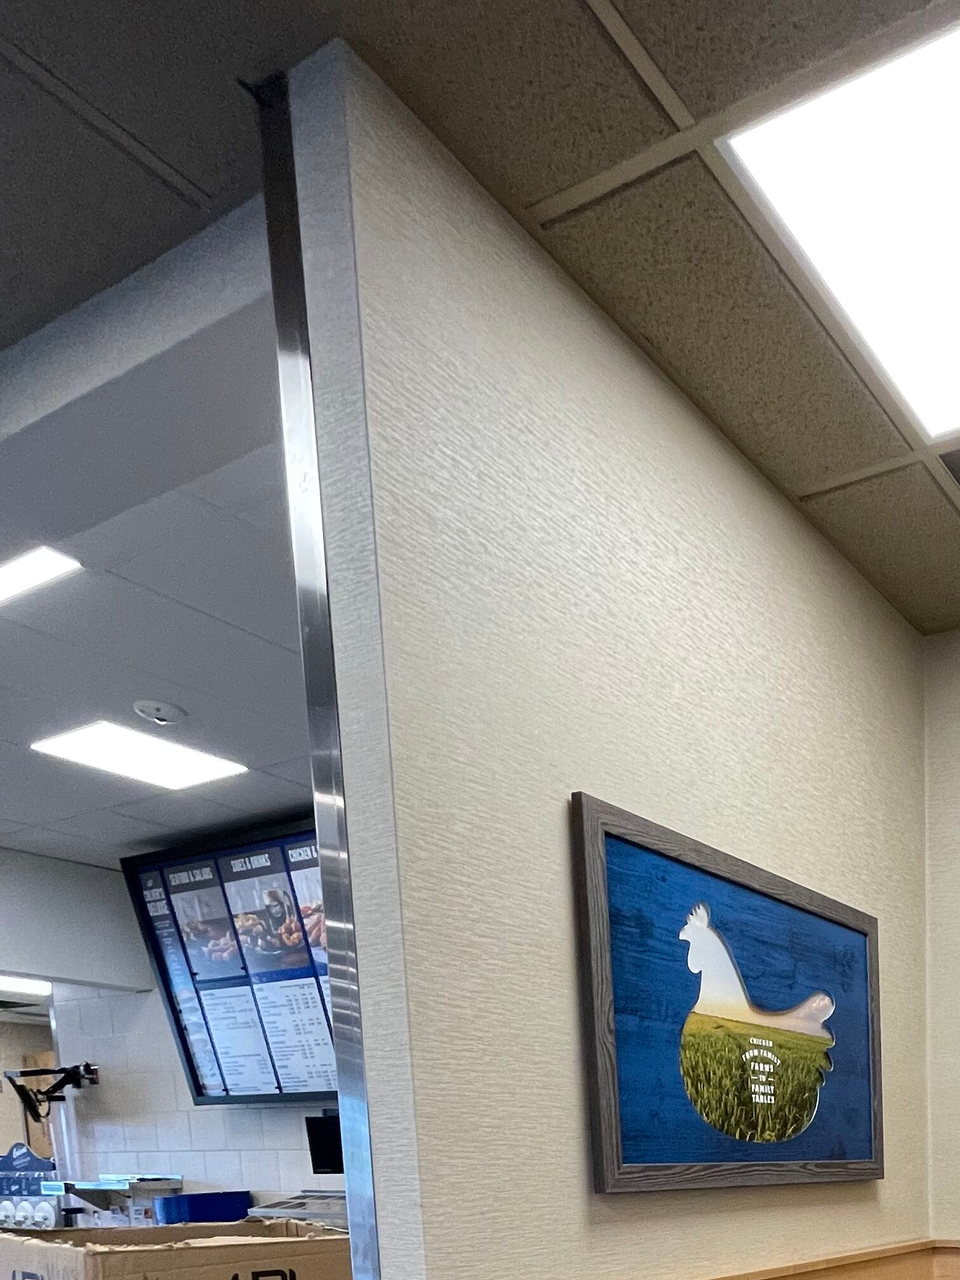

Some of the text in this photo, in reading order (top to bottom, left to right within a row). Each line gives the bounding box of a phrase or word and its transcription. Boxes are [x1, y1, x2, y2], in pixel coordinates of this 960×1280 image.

[749, 1037, 773, 1047] CHICKEN
[742, 1049, 781, 1066] FROM FAMILY
[750, 1061, 774, 1073] FARMS
[759, 1074, 766, 1082] TO
[751, 1083, 775, 1094] FAMILY
[751, 1094, 775, 1104] TABLES
